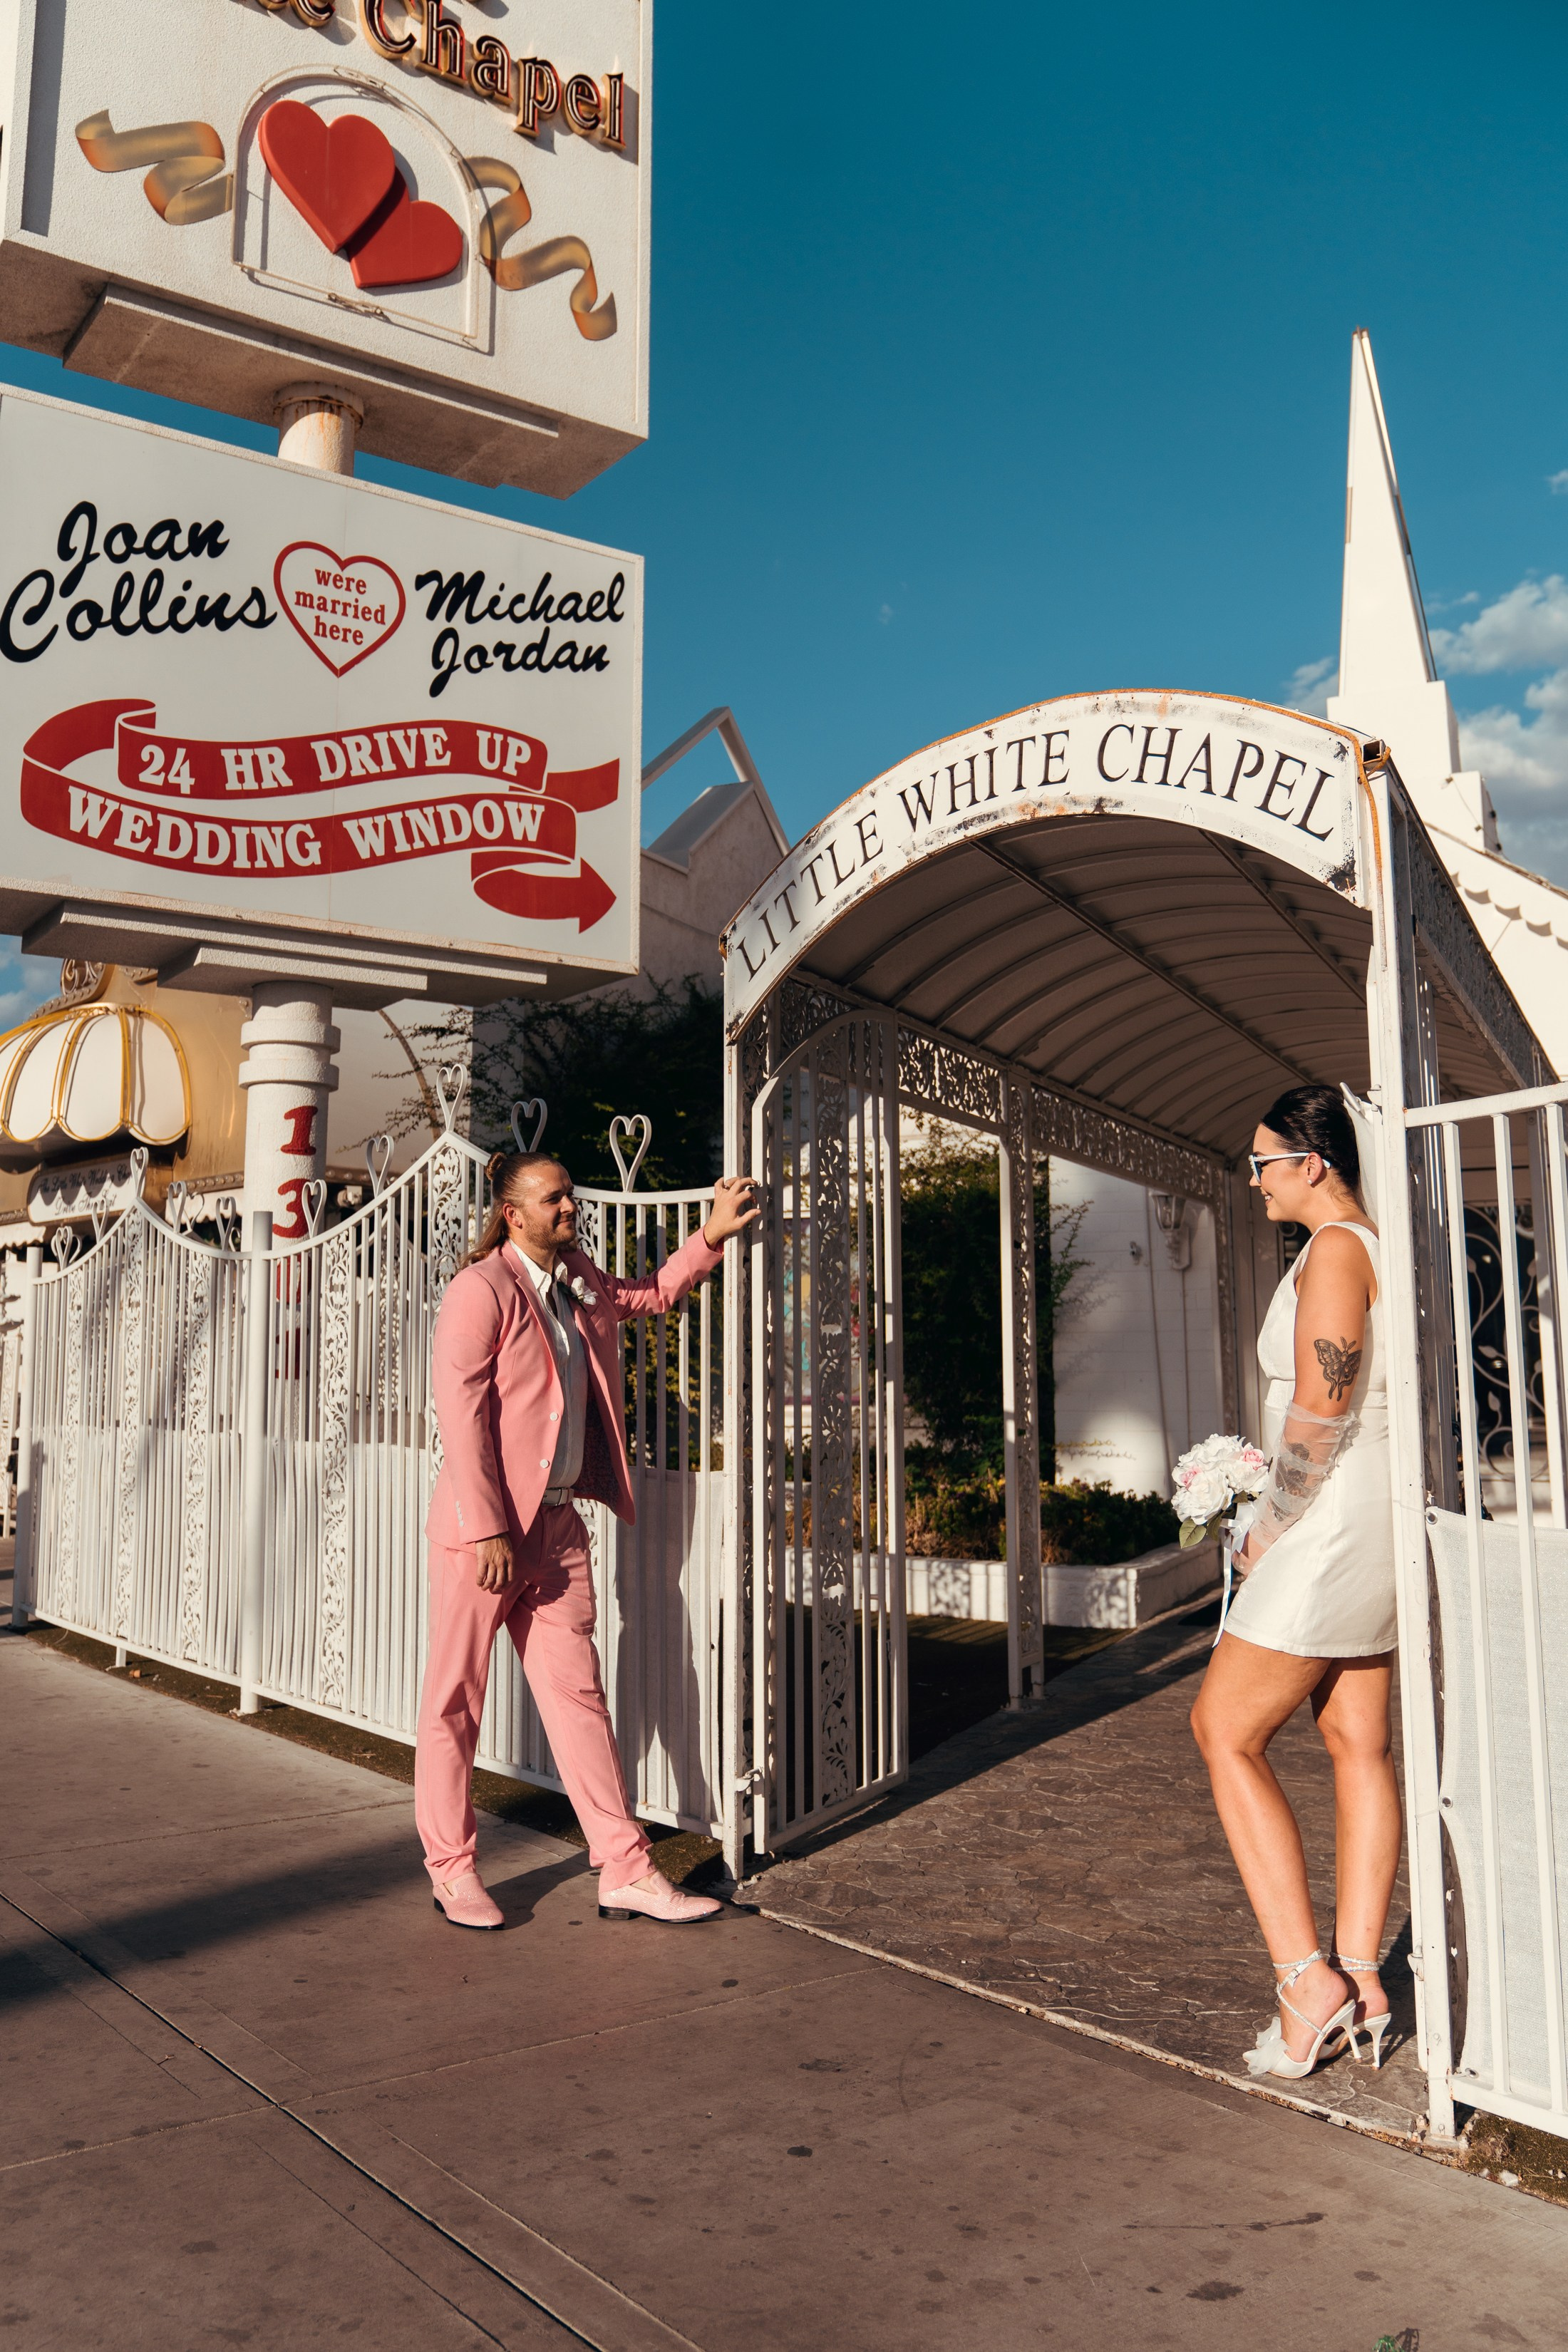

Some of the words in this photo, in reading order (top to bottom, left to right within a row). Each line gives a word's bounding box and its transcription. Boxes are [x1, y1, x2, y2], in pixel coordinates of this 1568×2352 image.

[361, 0, 626, 152] Chapel
[56, 500, 230, 599] Joan
[314, 568, 367, 595] were
[0, 567, 278, 664] Collins
[294, 590, 386, 625] married
[314, 614, 364, 646] here
[414, 569, 626, 625] Michael
[429, 626, 611, 698] Jordan
[138, 743, 196, 795] 24
[220, 746, 294, 790] HR
[311, 727, 452, 783] DRIVE
[476, 730, 532, 777] UP
[68, 785, 322, 869] WEDDING
[342, 799, 545, 860] WINDOW
[736, 810, 884, 982] LITTLE
[897, 729, 1070, 833] WHITE
[1098, 723, 1335, 842] CHAPEL
